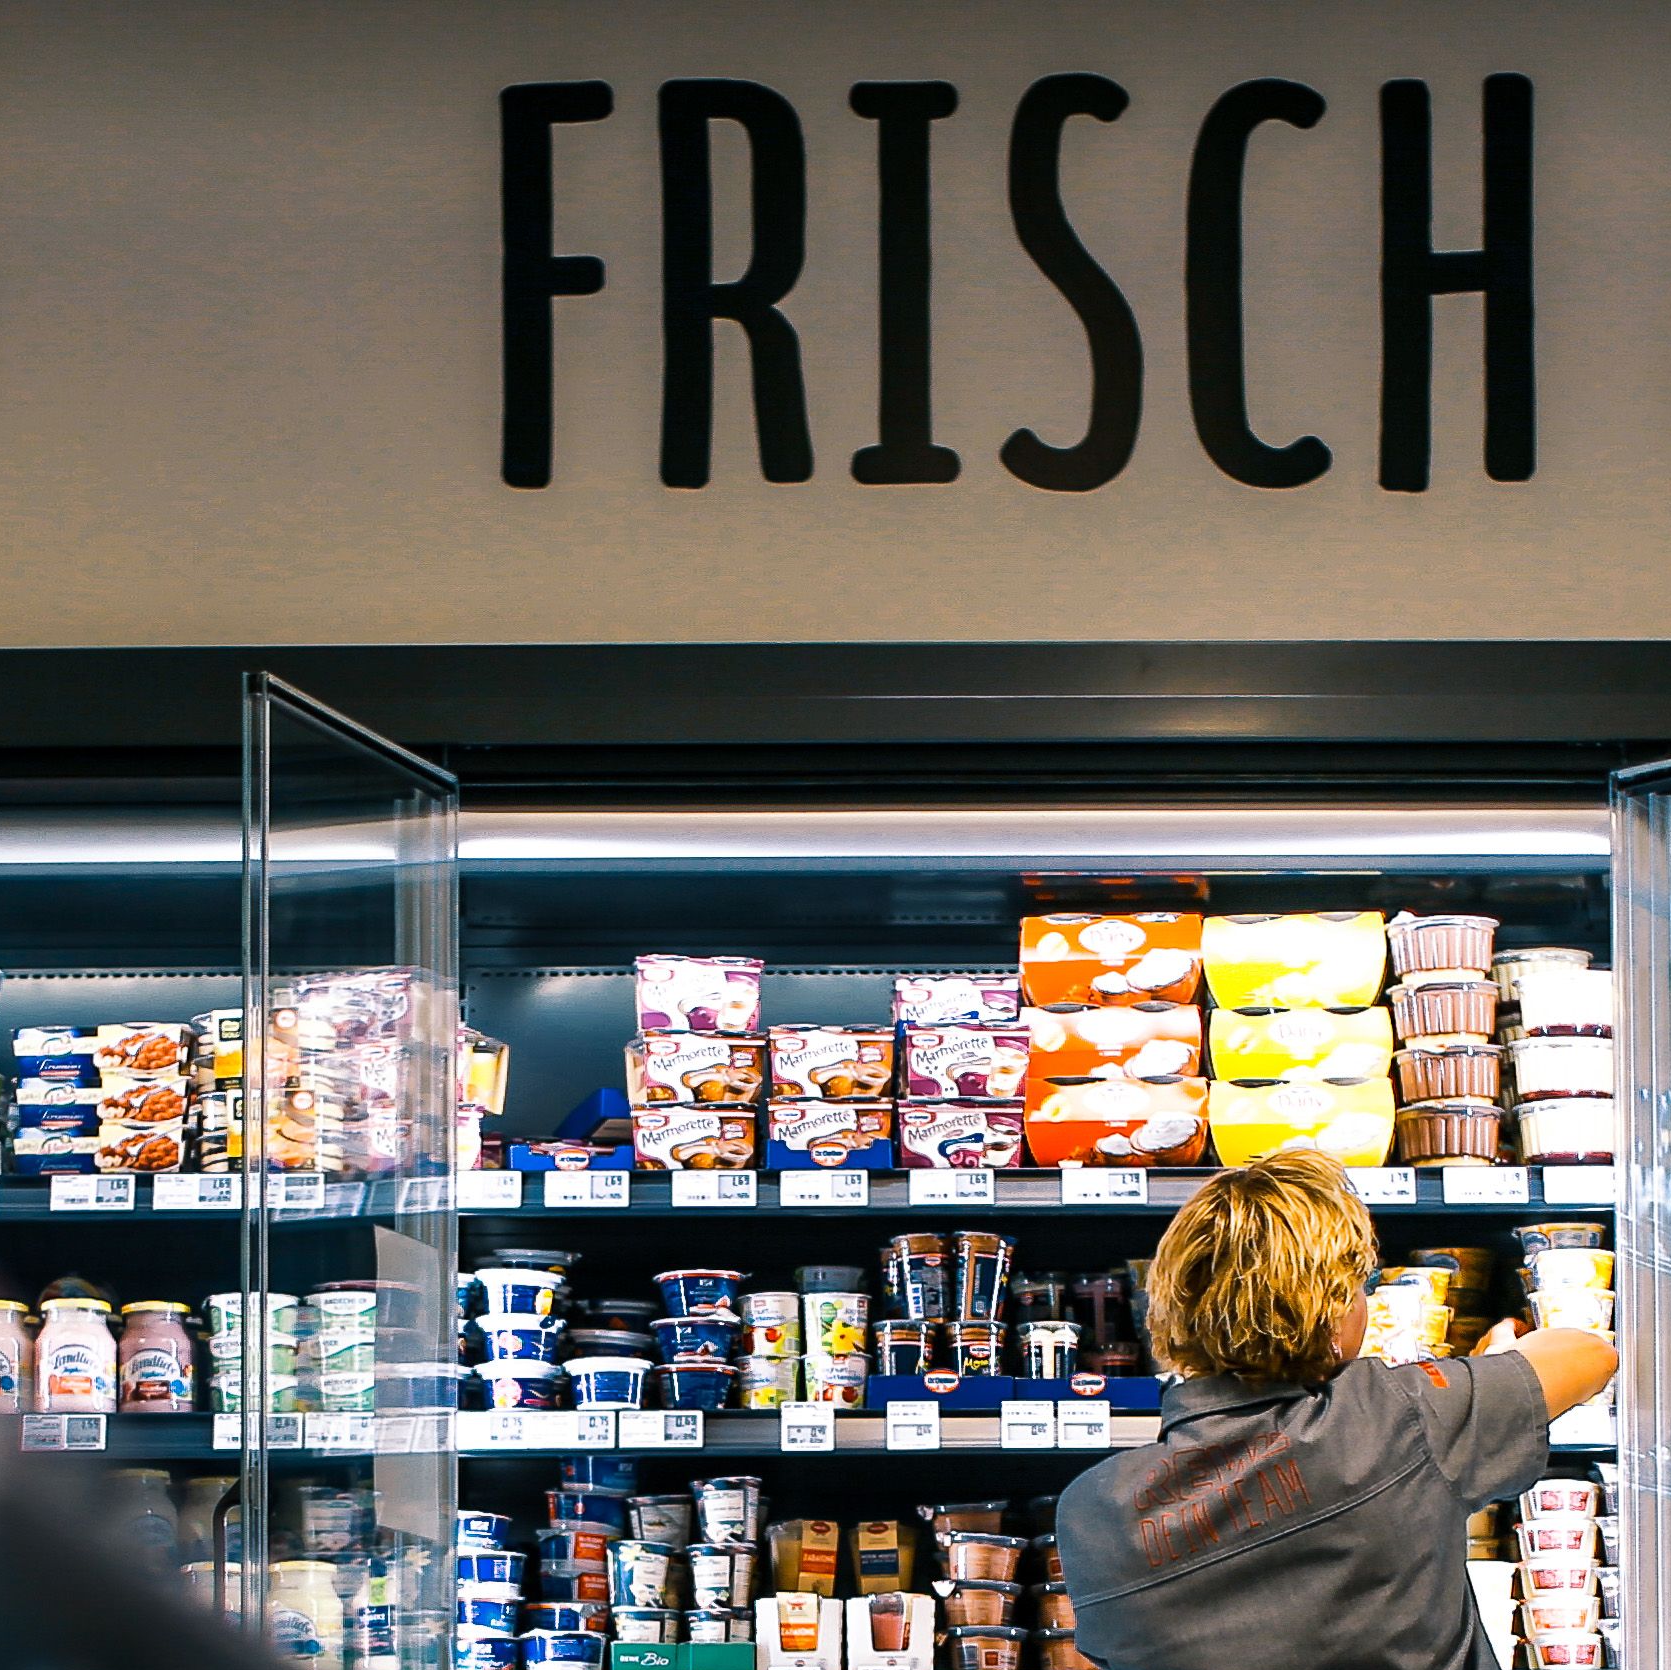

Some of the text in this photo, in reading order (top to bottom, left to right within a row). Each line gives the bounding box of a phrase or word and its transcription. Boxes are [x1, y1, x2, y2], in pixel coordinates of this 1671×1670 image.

[500, 72, 1534, 491] FRISCH
[653, 1043, 725, 1070] Marmorette
[780, 1042, 852, 1069] Marmorette
[916, 1037, 989, 1065] Marmorette
[641, 1118, 715, 1148] Marmorette
[778, 1111, 851, 1140] Marmorette
[908, 1113, 981, 1143] Marmorette
[1140, 1459, 1312, 1568] DEIN TEAM
[640, 1652, 670, 1667] Bio
